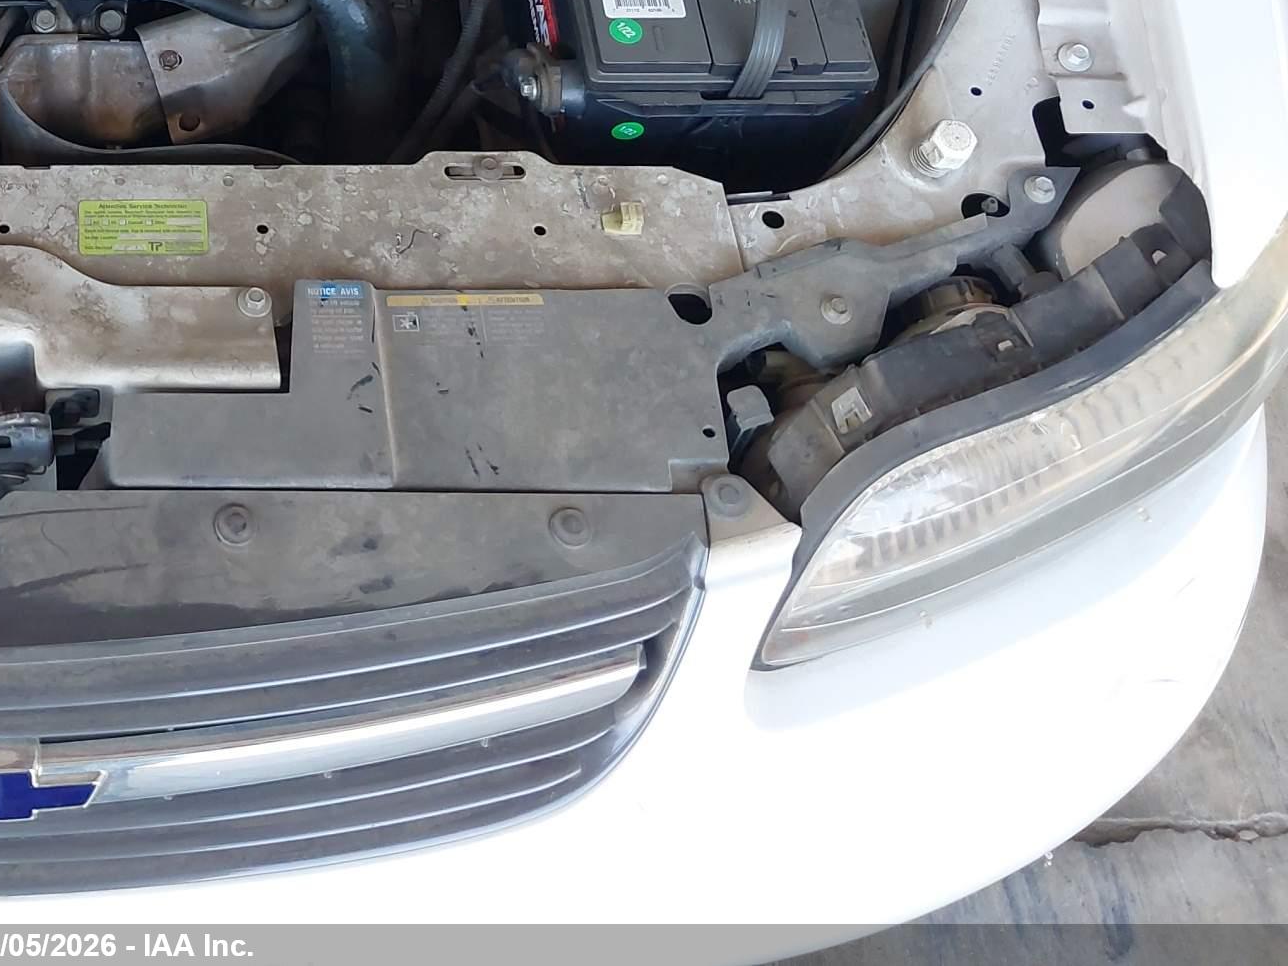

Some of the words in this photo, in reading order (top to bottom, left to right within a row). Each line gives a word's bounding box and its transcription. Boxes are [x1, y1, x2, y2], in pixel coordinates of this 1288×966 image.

[616, 21, 636, 39] 1/22
[307, 287, 337, 296] NOTICE
[340, 287, 359, 296] AVIS
